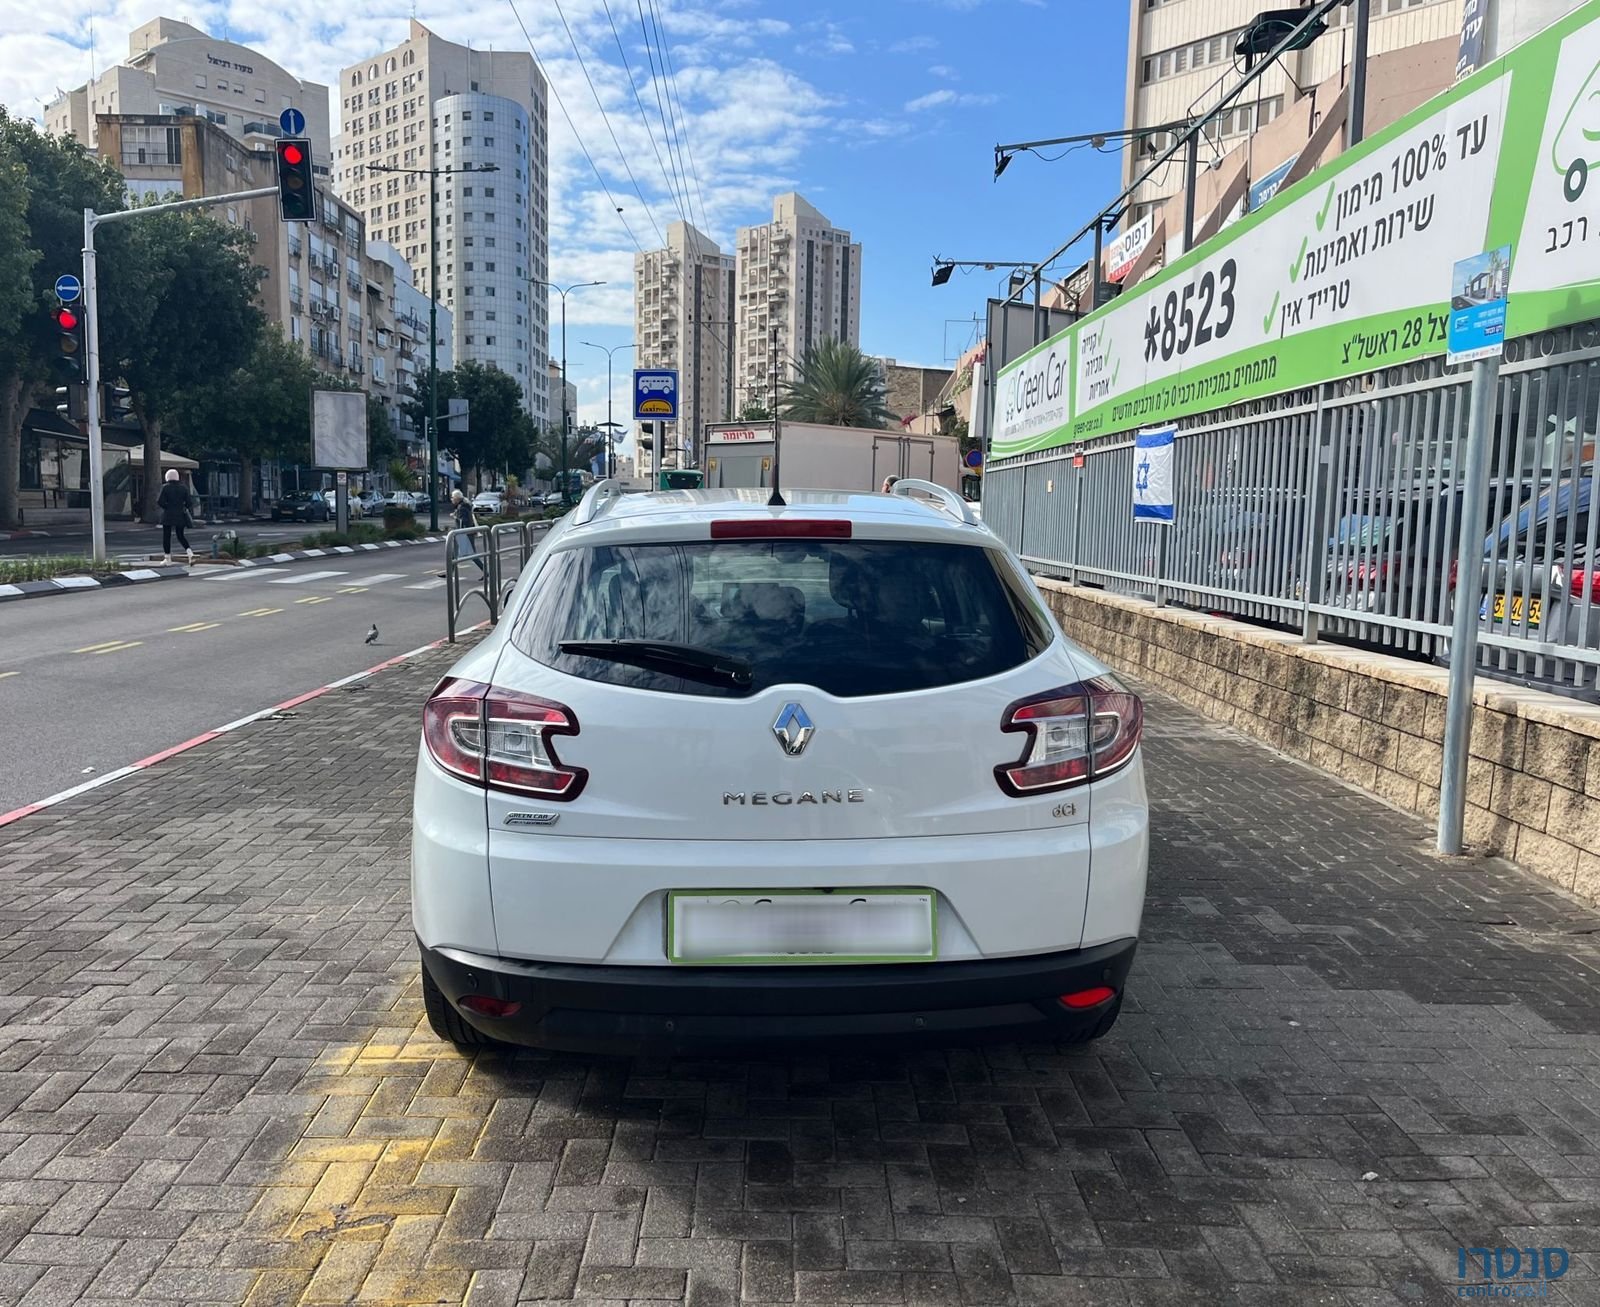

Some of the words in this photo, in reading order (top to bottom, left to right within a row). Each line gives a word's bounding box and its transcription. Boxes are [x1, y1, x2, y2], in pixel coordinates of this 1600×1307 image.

[1457, 114, 1488, 160] עד
[1391, 133, 1448, 194] 100%
[1335, 172, 1383, 231] מימון
[1125, 222, 1148, 252] דפוס
[1372, 194, 1435, 250] שירות
[1545, 216, 1588, 253] רכב
[1303, 225, 1368, 280] ואמינות
[1307, 278, 1350, 320] טרייד
[1280, 298, 1304, 339] אין
[1401, 317, 1423, 349] 28
[1016, 369, 1044, 414] Green
[1046, 351, 1067, 401] Car
[1085, 355, 1103, 377] מכירה
[1233, 355, 1277, 389] מתמחים
[1088, 377, 1111, 401] אחריות
[1178, 381, 1195, 405] רכבי
[1197, 371, 1231, 400] במכירת
[1112, 402, 1132, 421] חדשים
[722, 430, 755, 440] מריומה
[723, 789, 864, 805] MEGANE
